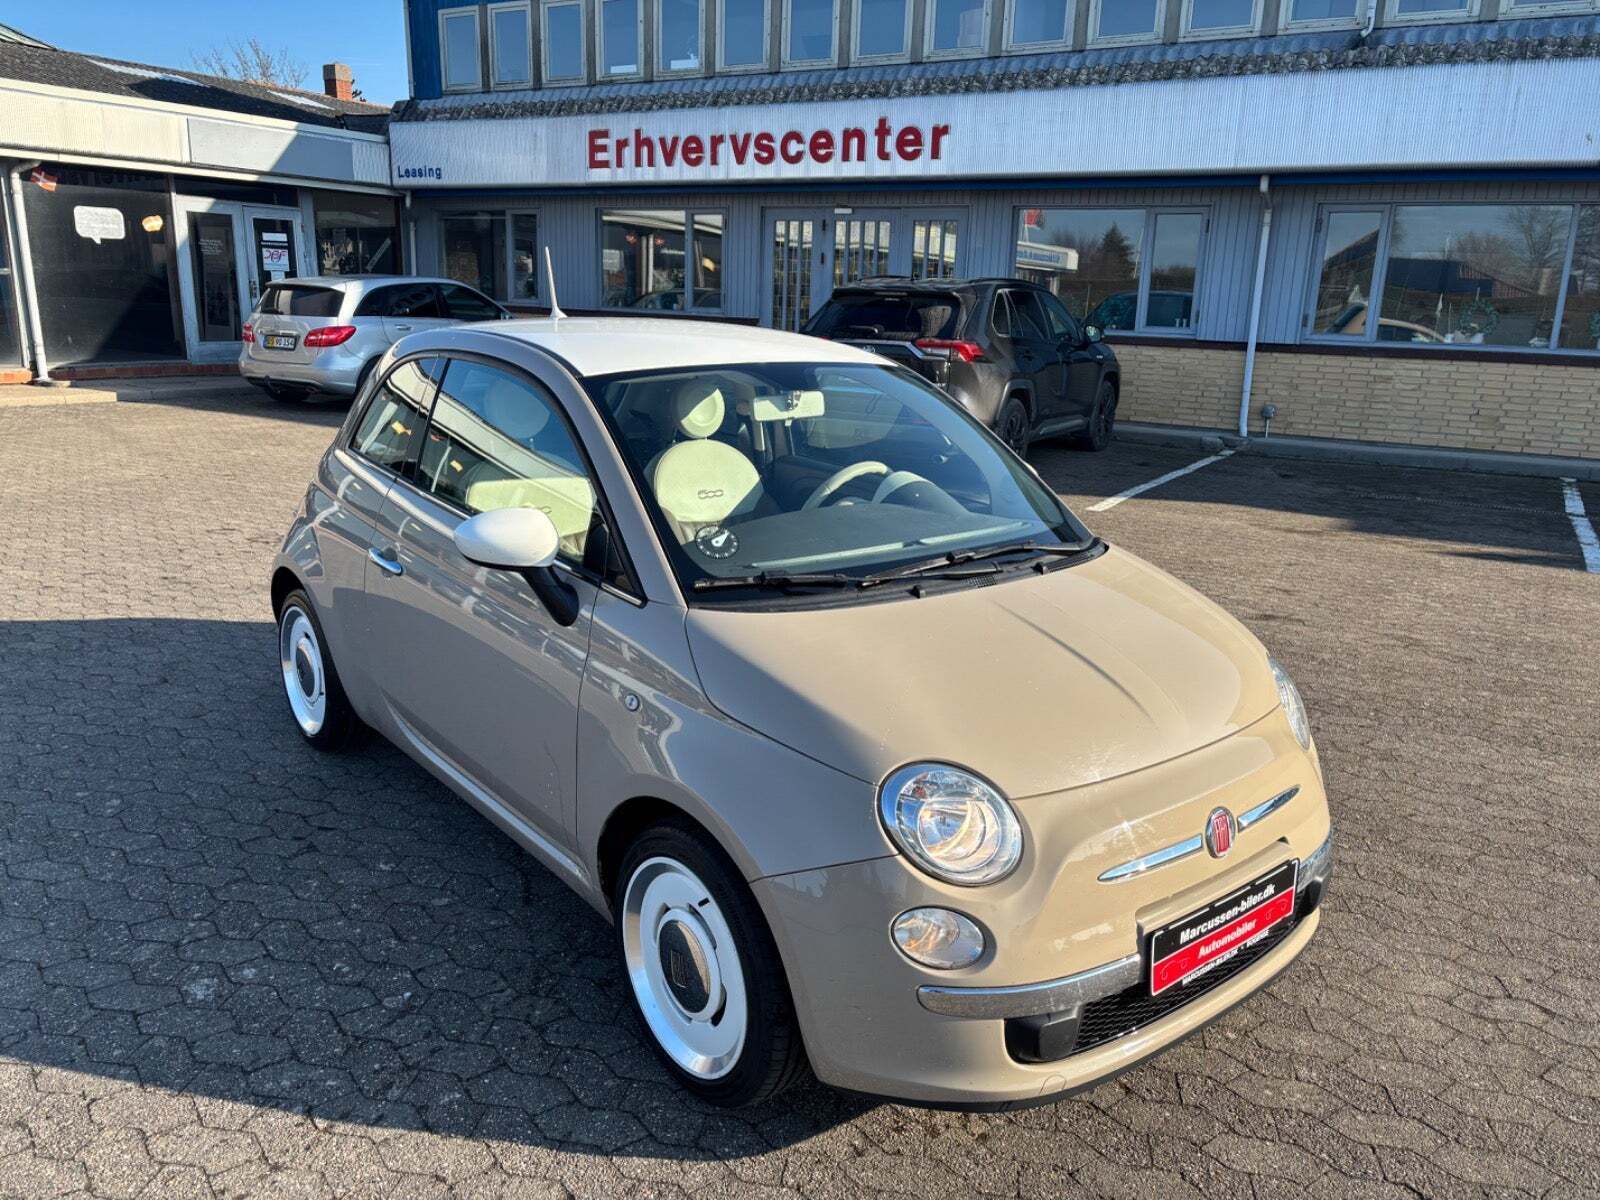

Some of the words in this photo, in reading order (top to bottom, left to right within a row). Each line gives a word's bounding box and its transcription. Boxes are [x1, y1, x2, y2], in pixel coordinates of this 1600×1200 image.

[587, 116, 951, 169] Erhvervscenter
[397, 165, 442, 180] Leasing
[1180, 883, 1276, 944] Marcussen-biler.dk
[1198, 919, 1257, 959] Automobiler
